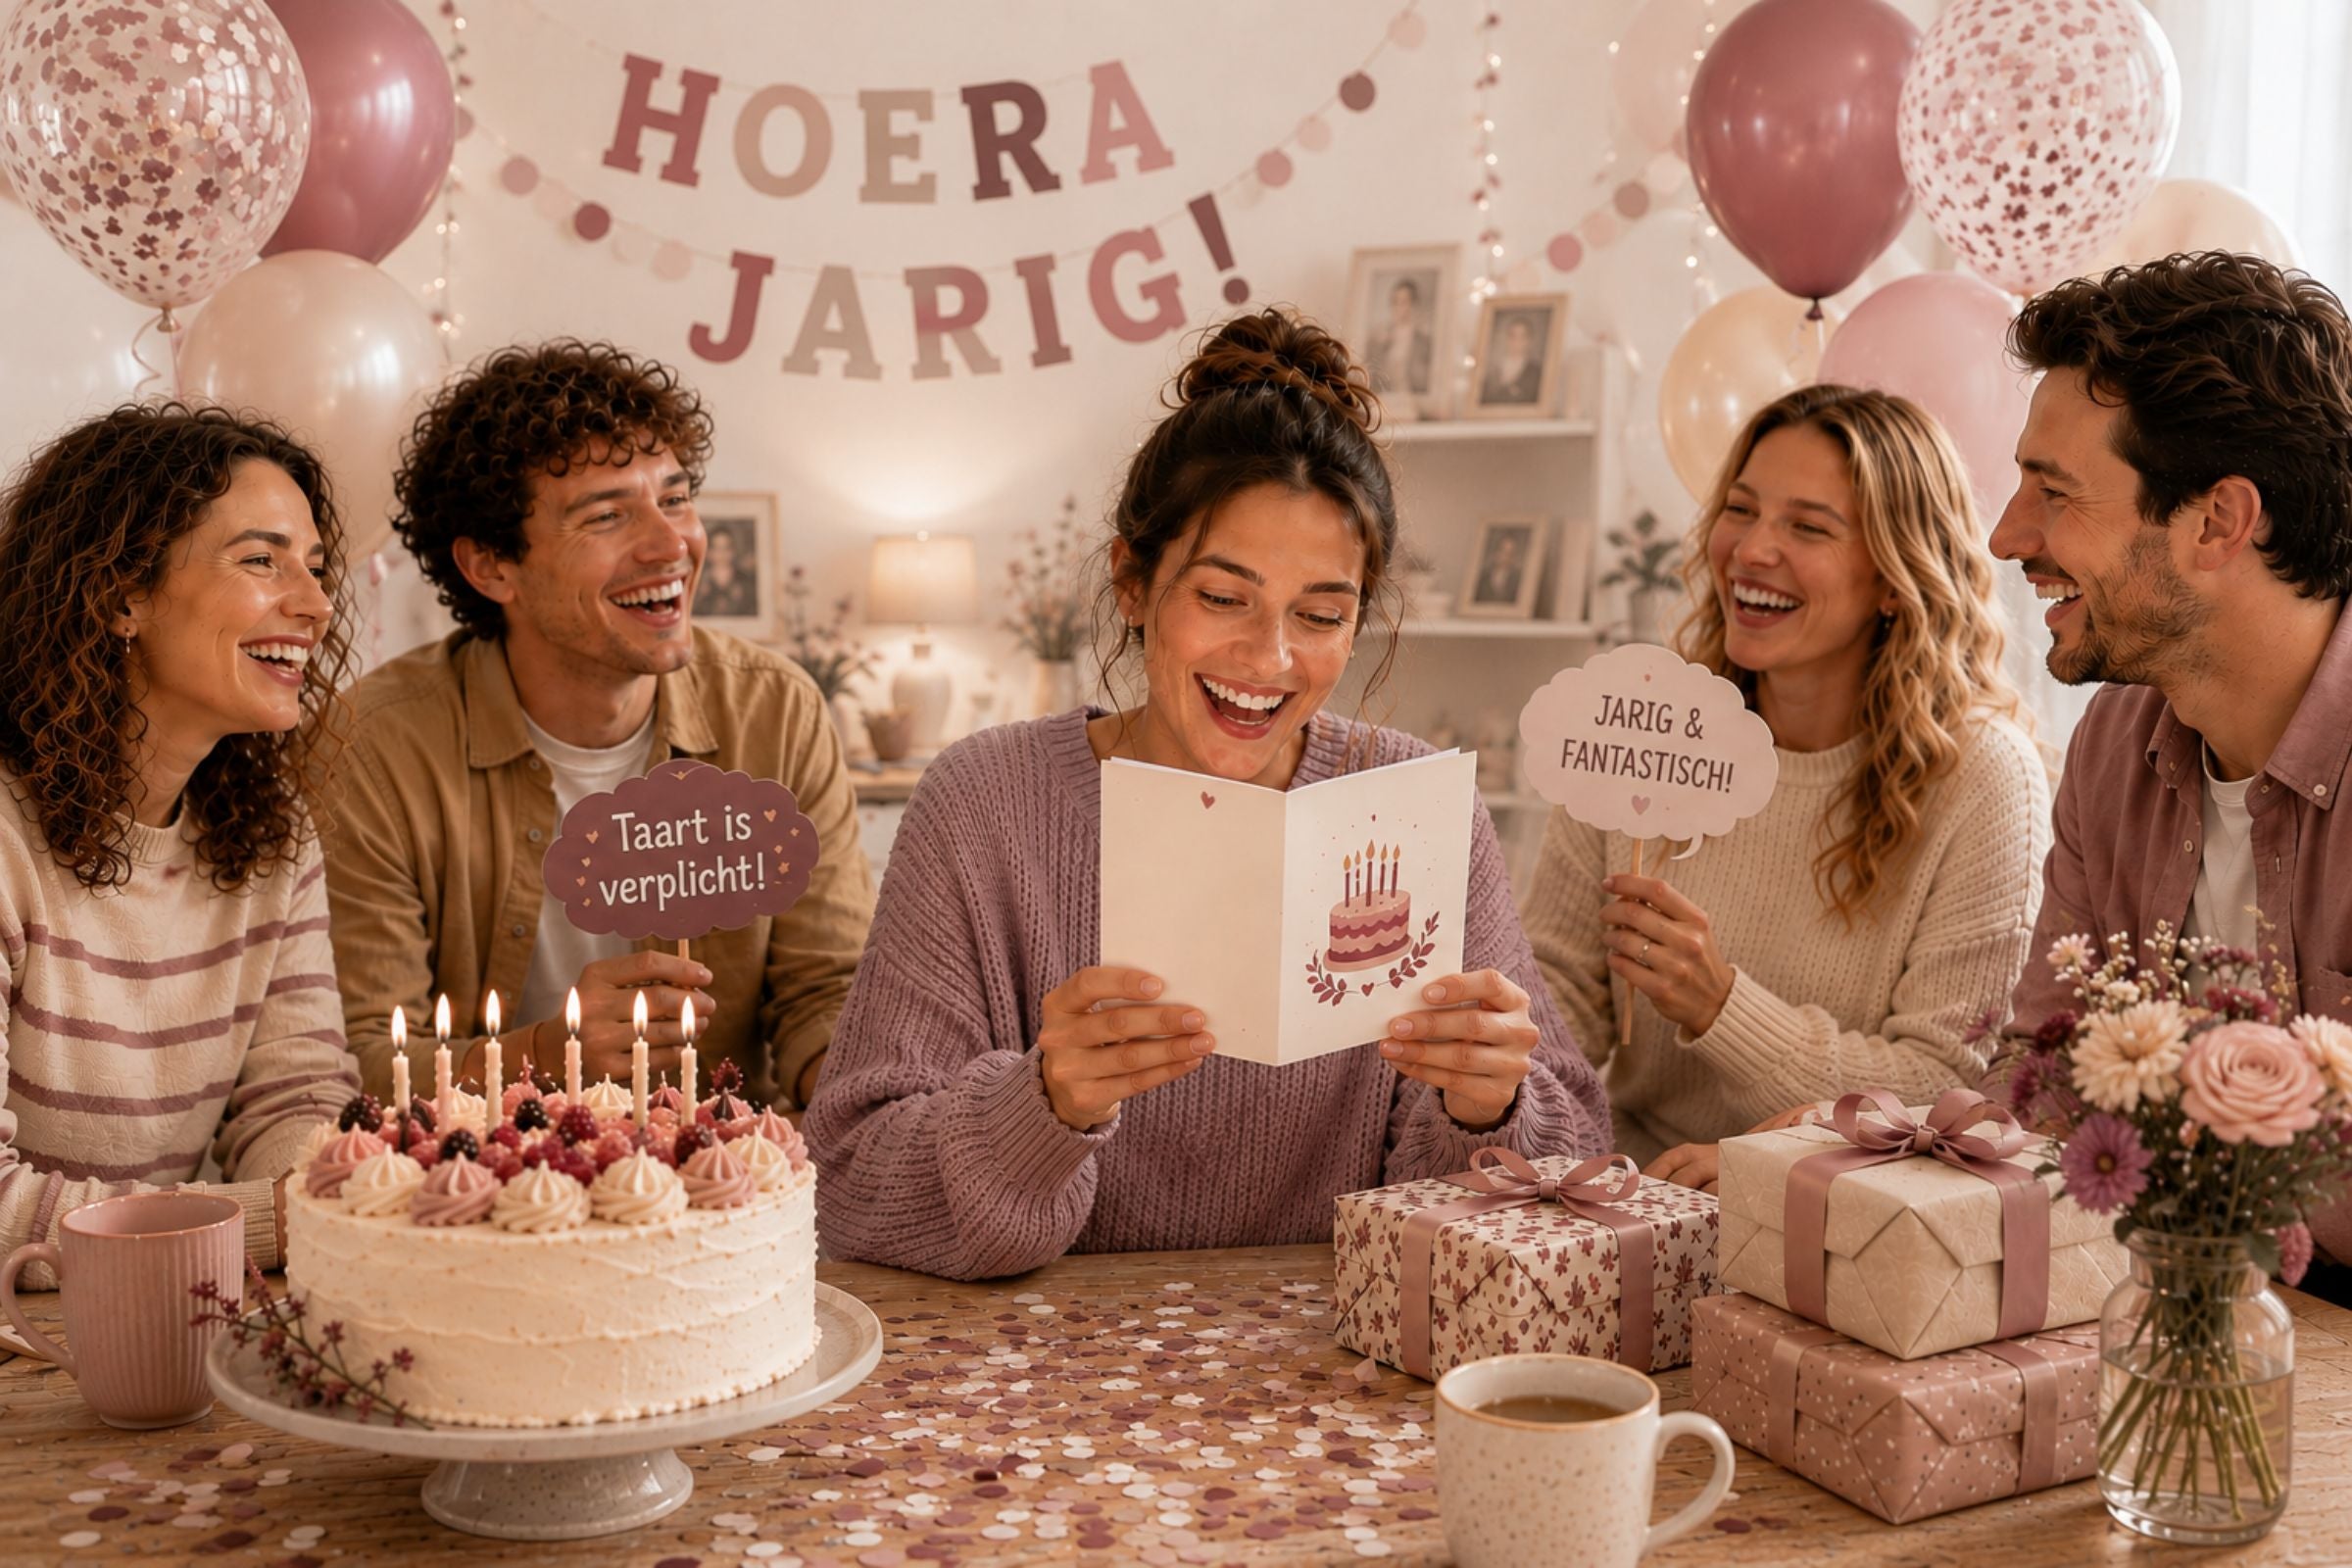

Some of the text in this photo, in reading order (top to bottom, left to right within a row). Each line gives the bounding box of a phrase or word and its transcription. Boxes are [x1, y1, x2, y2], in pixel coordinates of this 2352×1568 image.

[601, 52, 1175, 204] HOERA
[687, 192, 1250, 380] JARIG!
[1594, 695, 1703, 740] JARIG &
[1561, 739, 1735, 793] FANTASTISCH!
[612, 805, 753, 852] Taart is
[599, 852, 765, 911] verplicht!
